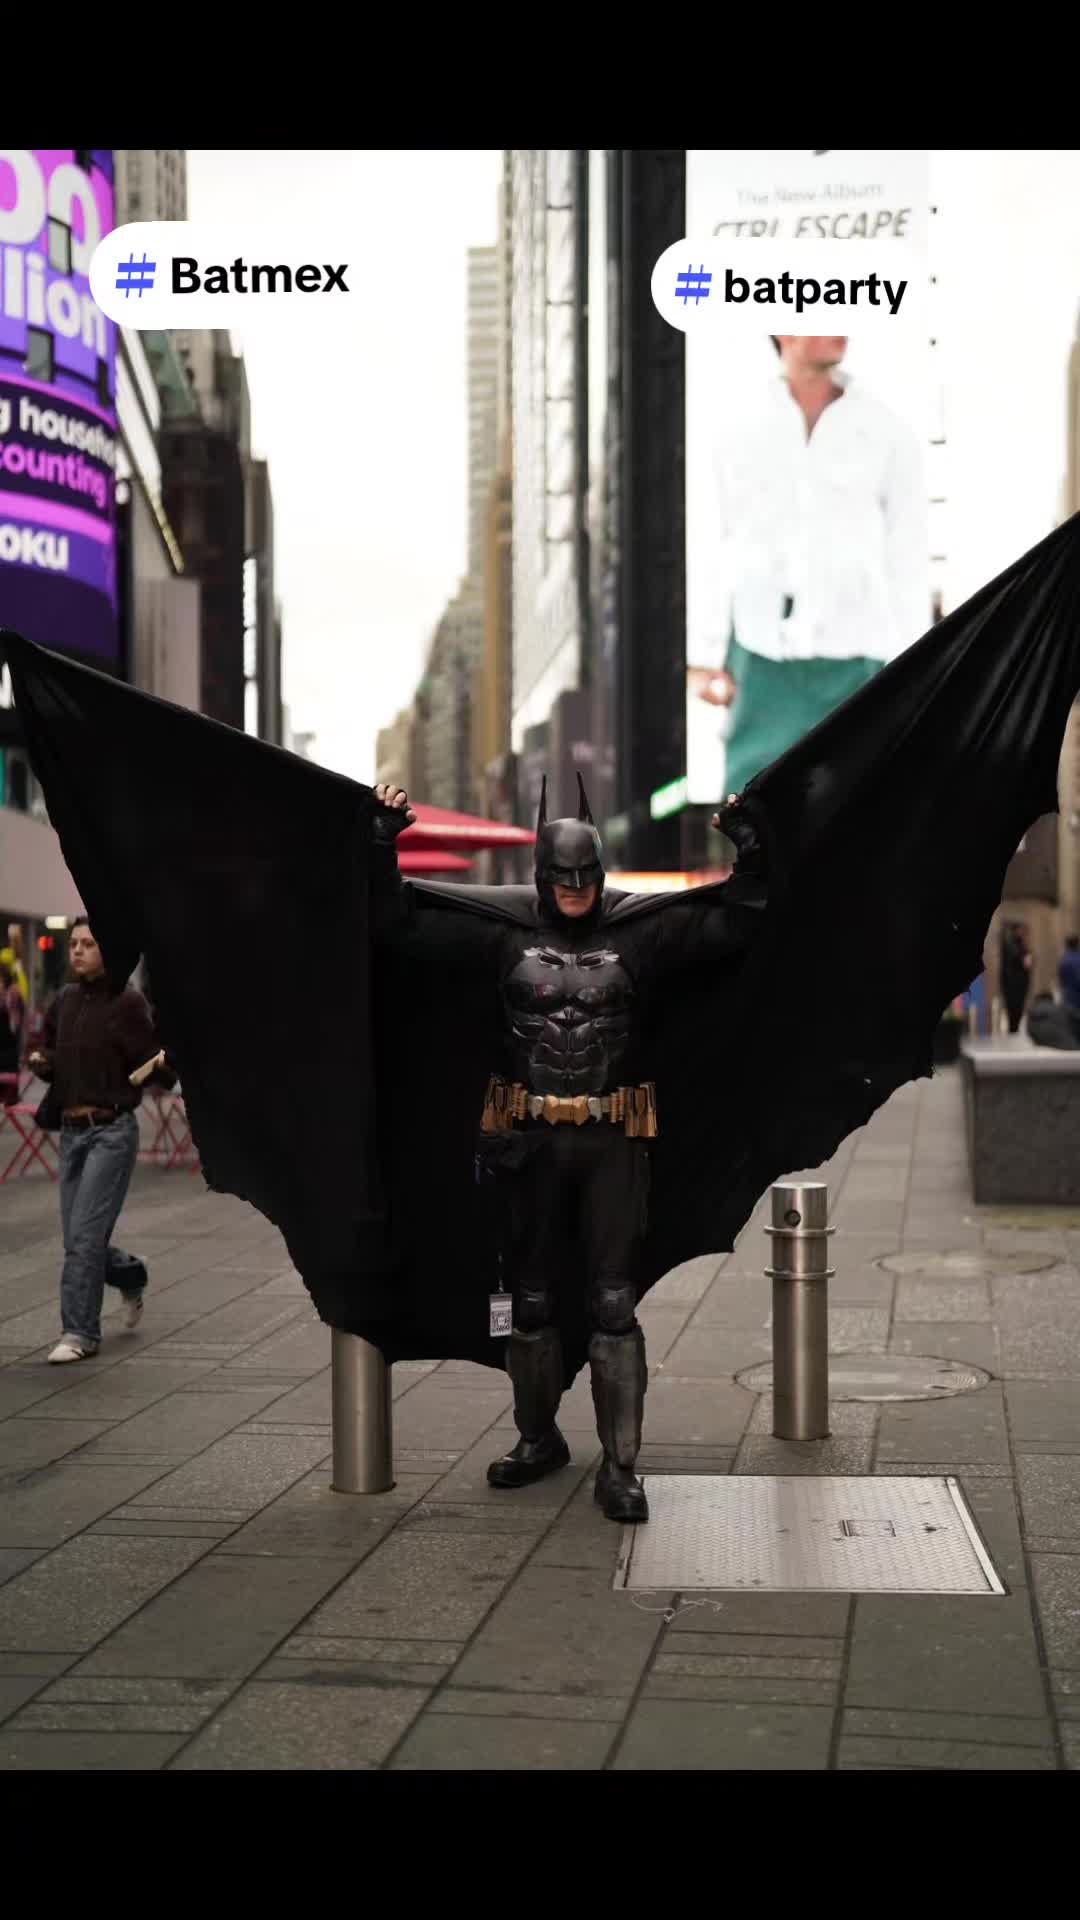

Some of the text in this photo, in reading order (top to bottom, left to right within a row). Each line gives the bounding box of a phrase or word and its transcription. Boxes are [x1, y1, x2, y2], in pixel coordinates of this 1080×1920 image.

[736, 181, 884, 207] The New Album
[792, 207, 912, 240] ESCAPE
[0, 246, 106, 358] lion
[0, 442, 106, 508] ounting
